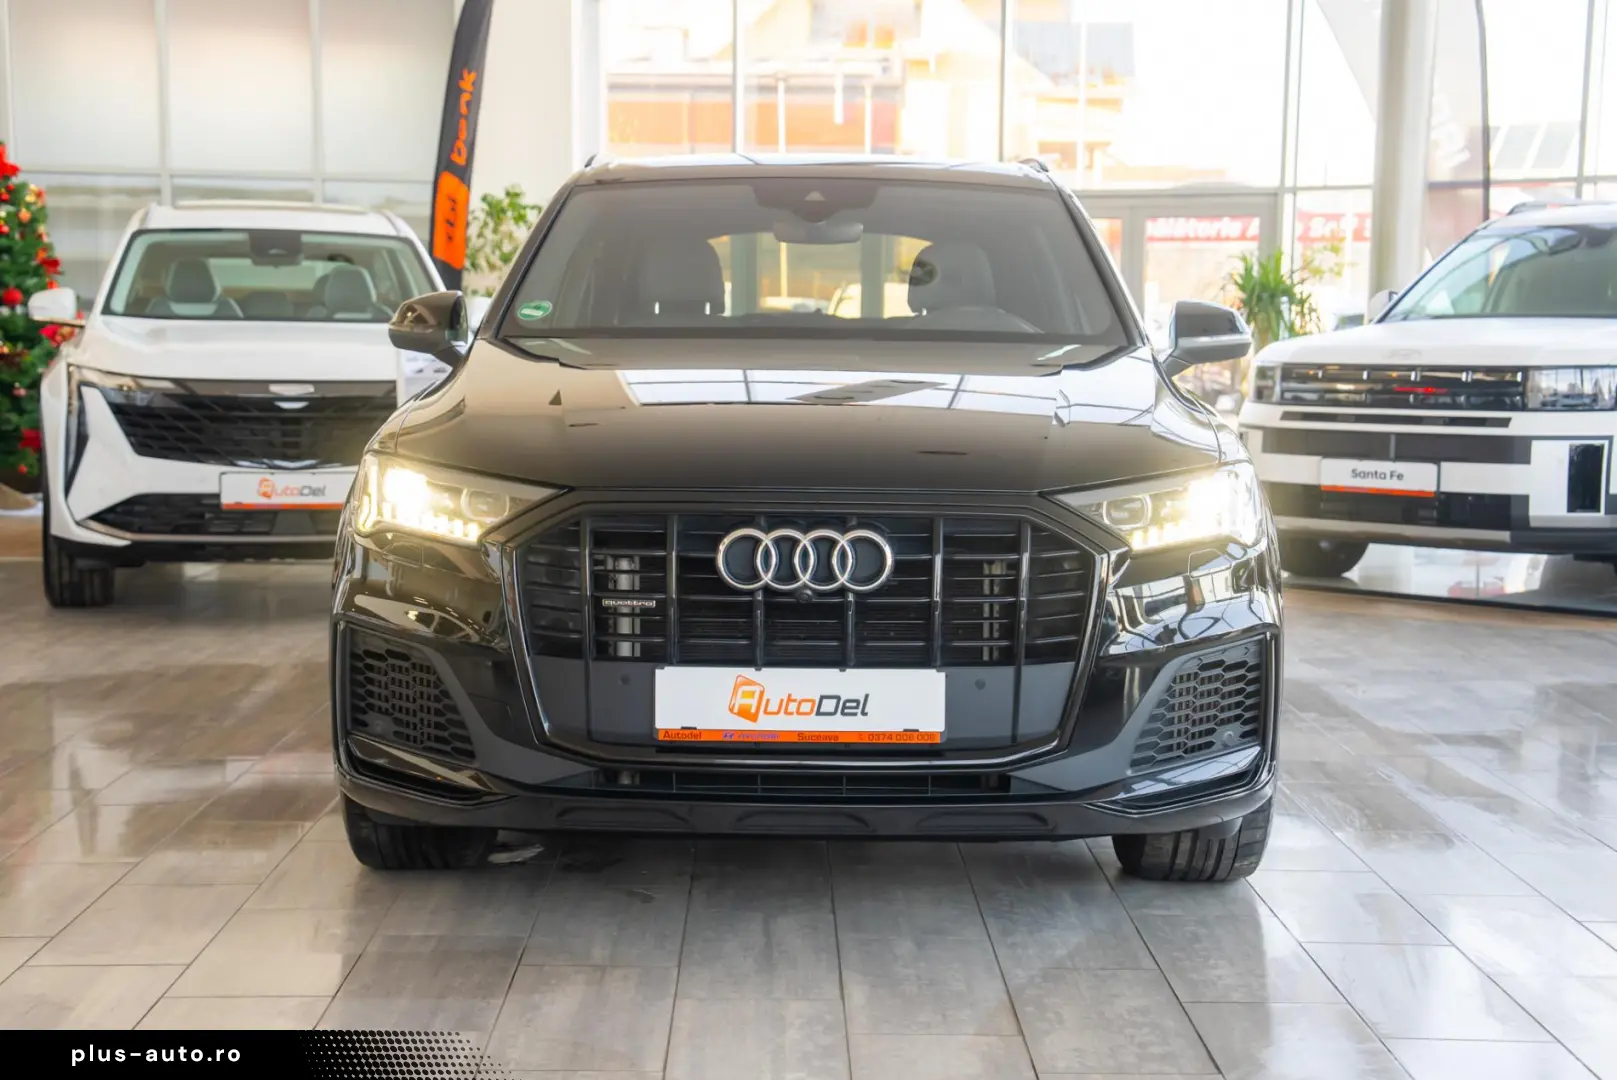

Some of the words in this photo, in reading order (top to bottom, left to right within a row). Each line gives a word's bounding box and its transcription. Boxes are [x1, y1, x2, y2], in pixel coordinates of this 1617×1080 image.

[1351, 468, 1387, 480] Santa
[1389, 470, 1404, 481] Fe
[729, 675, 869, 723] AutoDel
[662, 730, 702, 740] Autodel
[797, 732, 839, 742] Suceava
